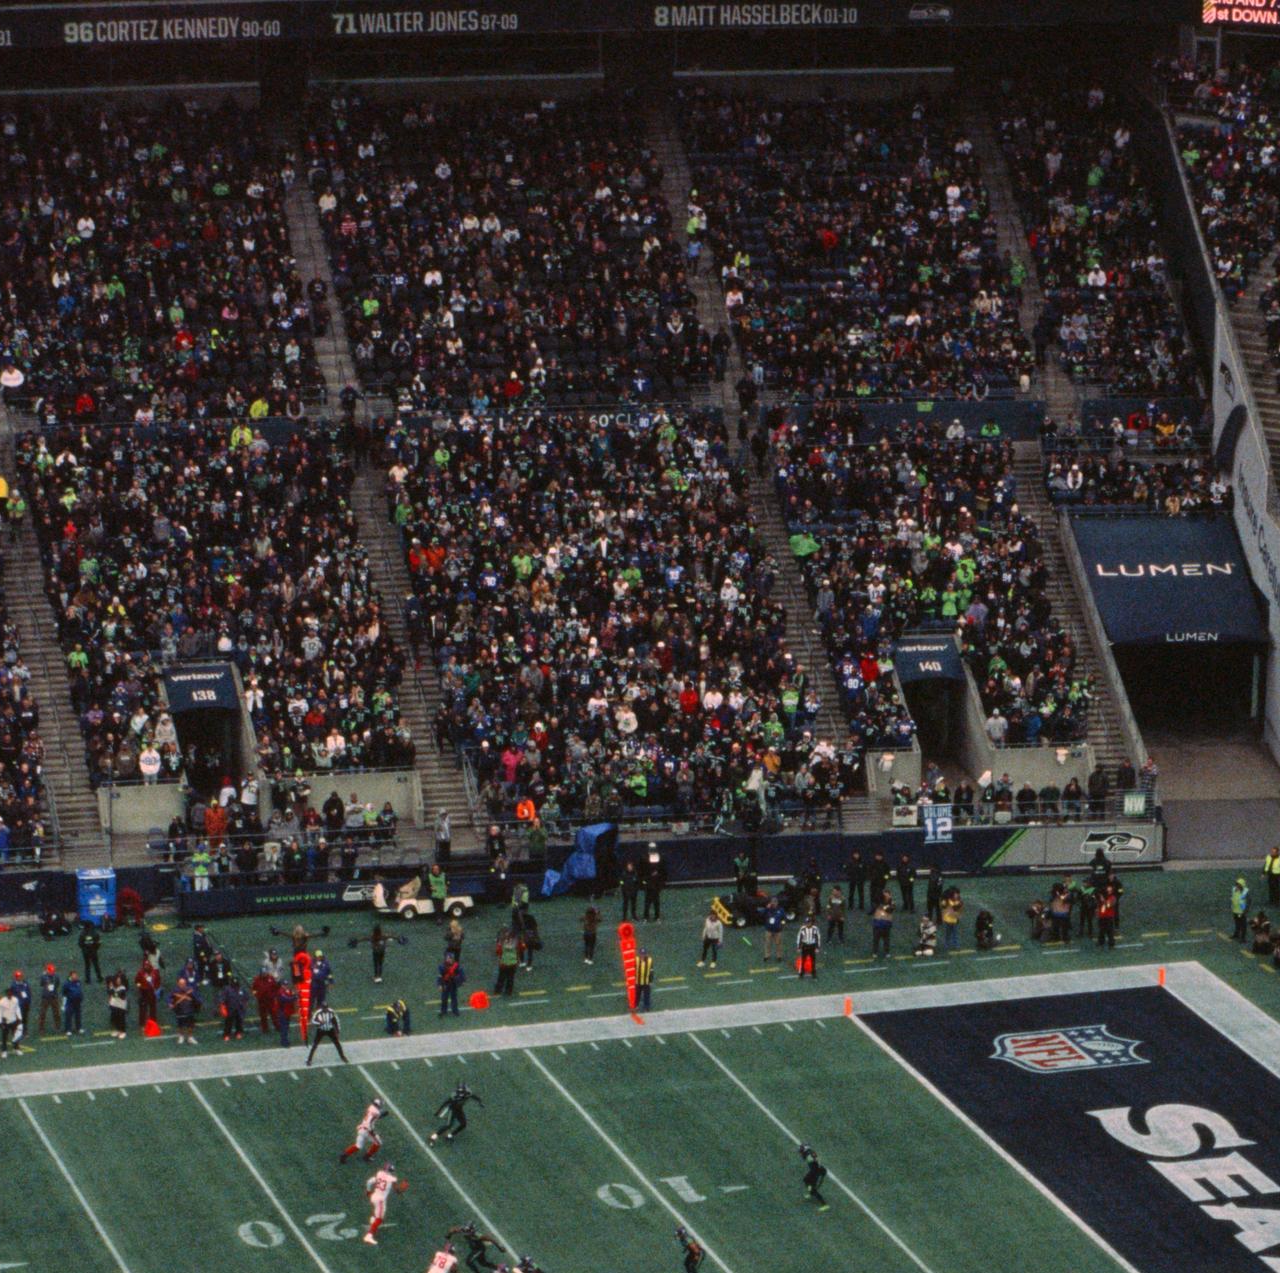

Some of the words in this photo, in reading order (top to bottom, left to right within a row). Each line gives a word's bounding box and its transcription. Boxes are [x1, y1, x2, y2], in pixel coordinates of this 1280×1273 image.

[332, 13, 358, 34] 71
[359, 12, 425, 34] WALTER
[427, 10, 480, 32] JONES
[654, 6, 670, 26] 8
[671, 5, 716, 26] MATT
[720, 4, 821, 26] HASSELBECK
[64, 21, 94, 42] 96
[96, 19, 160, 41] CORTEZ
[163, 16, 240, 40] KENNEDY
[1095, 563, 1233, 577] LUMEN
[1165, 632, 1219, 642] LUMEN
[171, 672, 222, 682] verizon
[919, 661, 942, 672] 140
[192, 689, 217, 701] 138
[924, 817, 952, 840] 12
[1010, 1033, 1097, 1068] NFL
[596, 1174, 709, 1211] 10
[236, 1212, 360, 1249] 20
